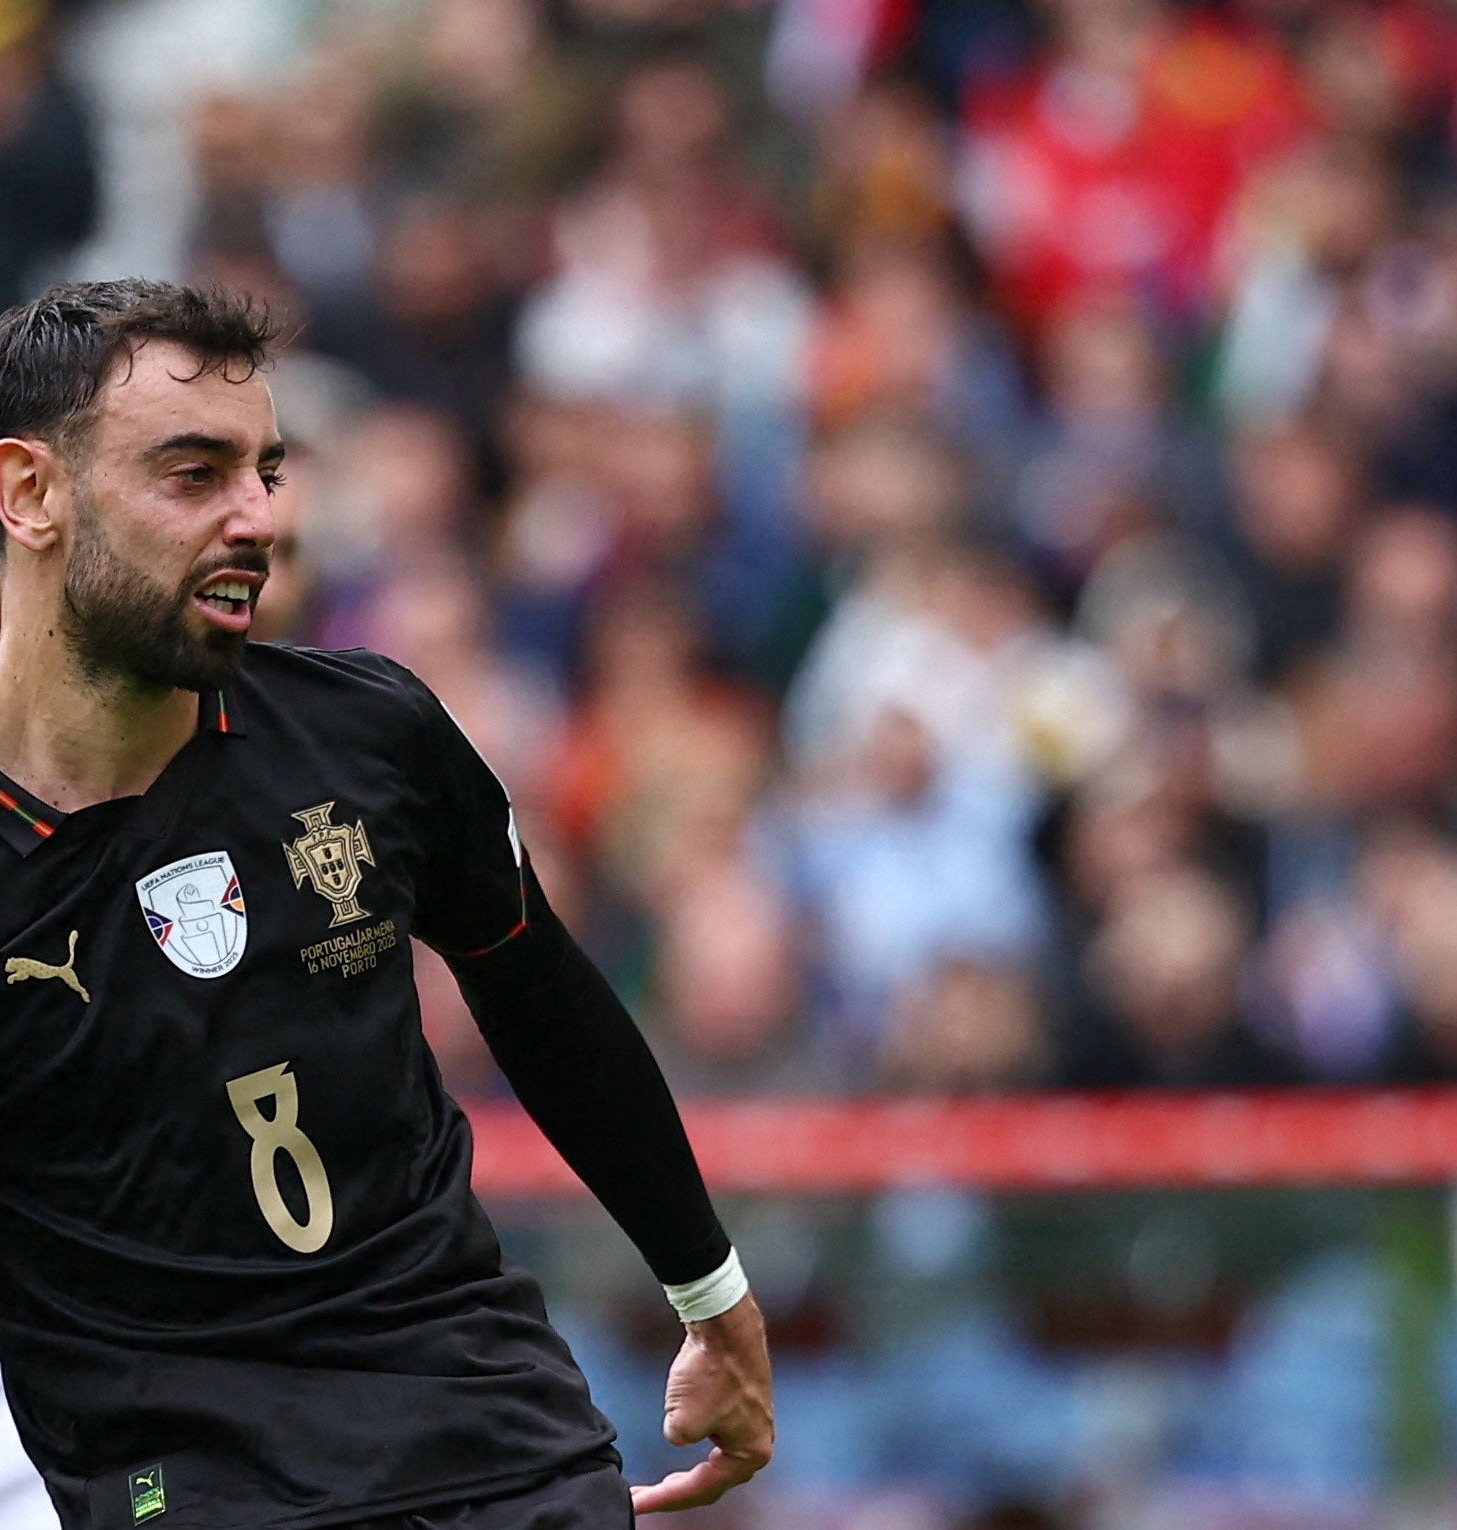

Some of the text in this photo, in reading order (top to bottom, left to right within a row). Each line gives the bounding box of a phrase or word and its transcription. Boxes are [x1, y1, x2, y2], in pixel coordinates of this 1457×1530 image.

[141, 856, 225, 891] UEFA NATIONS LEAGUE
[191, 951, 240, 975] WINNER 2025
[307, 961, 320, 975] 16
[320, 942, 376, 971] NOVEMBRO
[342, 955, 378, 979] PORTO
[225, 1061, 334, 1254] 8
